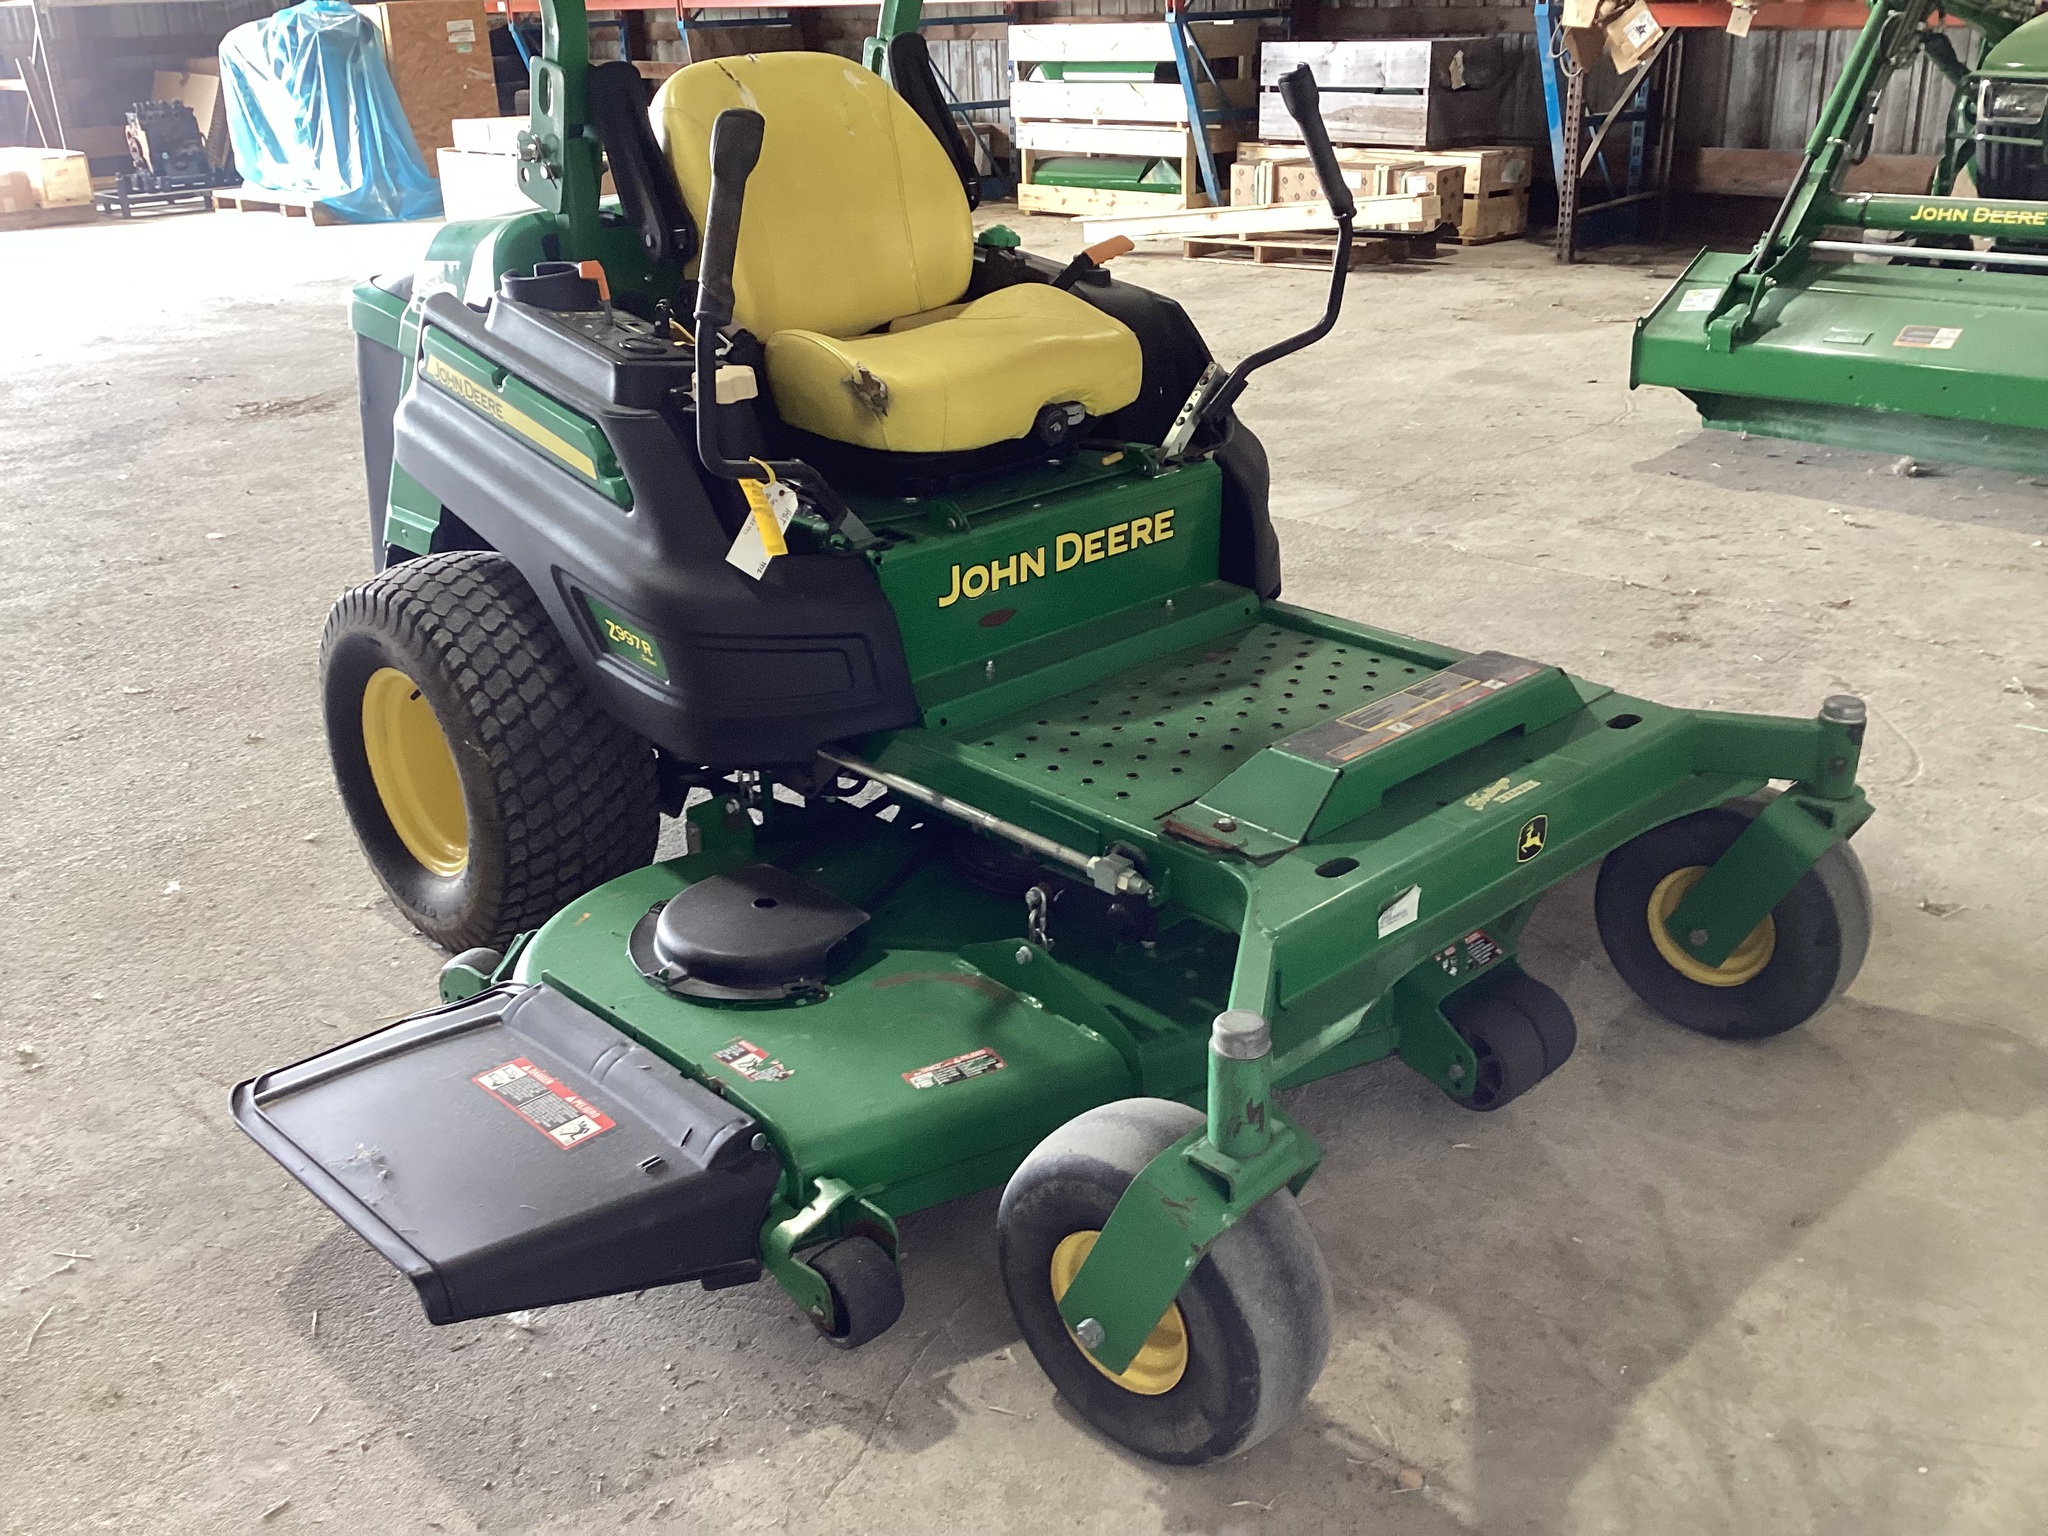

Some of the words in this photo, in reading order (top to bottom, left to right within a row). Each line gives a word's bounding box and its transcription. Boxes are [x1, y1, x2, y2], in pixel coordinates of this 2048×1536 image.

[1910, 204, 1969, 222] JOHN
[1972, 207, 2048, 226] DEERE
[434, 361, 464, 396] JOHN
[464, 380, 505, 421] DEERE
[937, 546, 1046, 609] JOHN
[1055, 508, 1176, 573] DEERE
